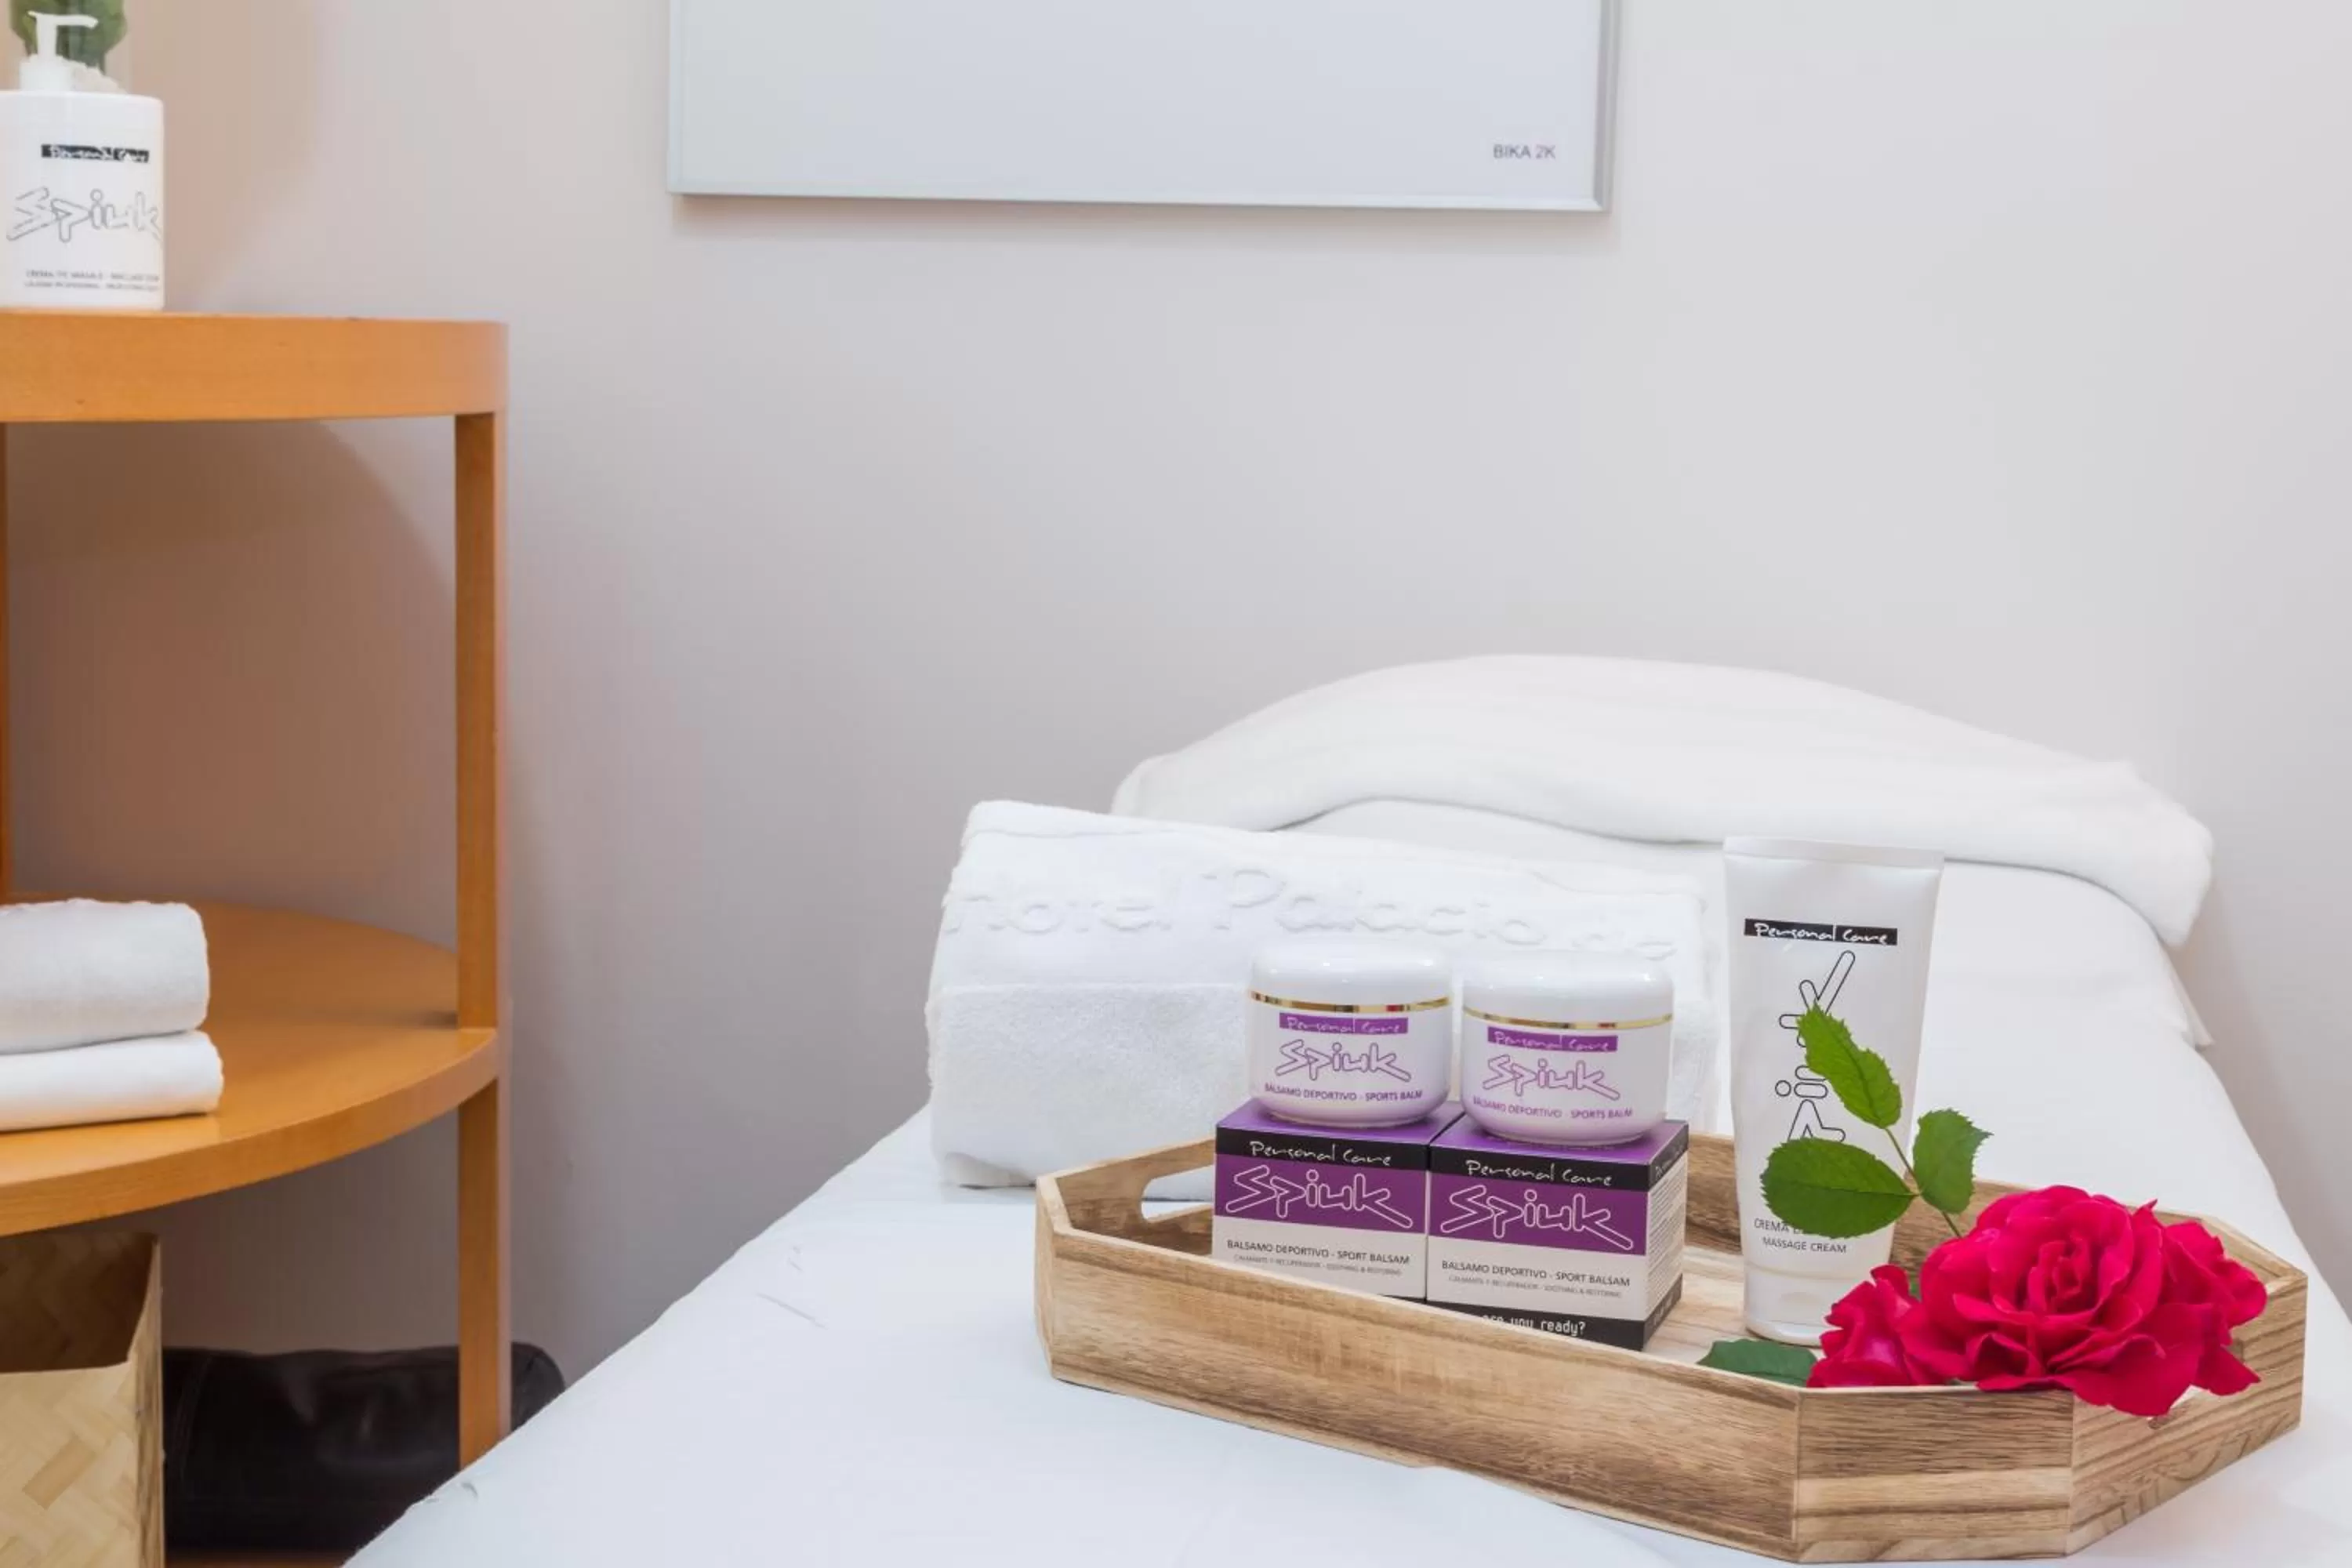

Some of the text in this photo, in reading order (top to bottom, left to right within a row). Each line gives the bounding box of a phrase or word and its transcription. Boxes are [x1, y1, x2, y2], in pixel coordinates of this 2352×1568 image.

[1493, 143, 1557, 159] BIKA 2K
[1754, 923, 1888, 946] Personal Care
[1287, 1016, 1356, 1033] Personal
[1494, 1031, 1563, 1050] Personal
[1275, 1039, 1412, 1082] Spiuk
[1483, 1054, 1621, 1101] Spiuk
[1265, 1082, 1301, 1097] BALSAMO
[1304, 1089, 1357, 1102] DEPORTIVO
[1508, 1104, 1563, 1118] DEPORTIVO
[1570, 1109, 1606, 1120] SPORTS
[1607, 1107, 1633, 1118] BALM
[1249, 1141, 1392, 1167] Personal Care
[1465, 1160, 1613, 1186] Personal Care
[1225, 1164, 1414, 1229] Spiuk
[1440, 1184, 1634, 1250] Spiuk
[1227, 1239, 1273, 1253] BALSAMO
[1276, 1243, 1330, 1258] DEPORTIVO
[1337, 1250, 1368, 1262] SPORT
[1369, 1253, 1410, 1266] BALSAM
[1762, 1236, 1847, 1253] MASSAGE CREAM
[1442, 1260, 1490, 1274] BALSAMO
[1492, 1264, 1547, 1279] DEPORTIVO
[1555, 1270, 1588, 1284] SPORT
[1588, 1274, 1631, 1287] BALSAM
[1541, 1319, 1586, 1337] ready?
